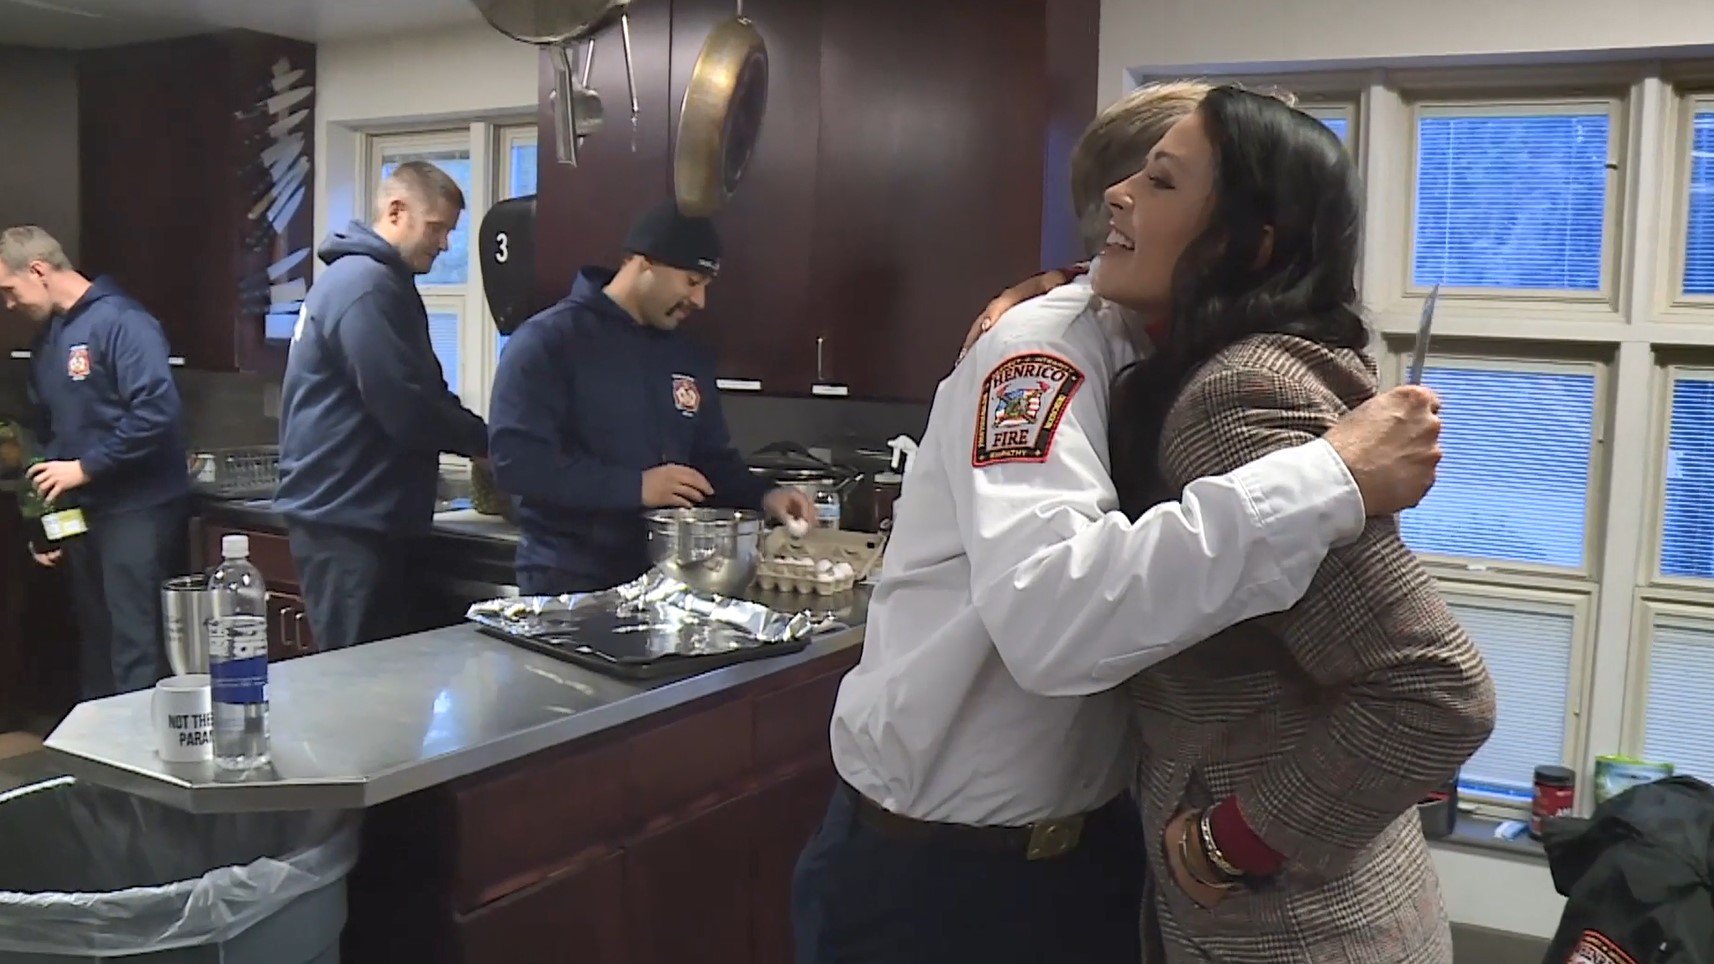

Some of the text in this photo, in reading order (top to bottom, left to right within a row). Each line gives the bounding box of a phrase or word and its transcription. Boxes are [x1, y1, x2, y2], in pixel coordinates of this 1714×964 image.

[496, 232, 508, 262] 3
[993, 364, 1066, 388] HENRICO
[992, 429, 1029, 447] FIRE
[168, 714, 189, 729] NOT
